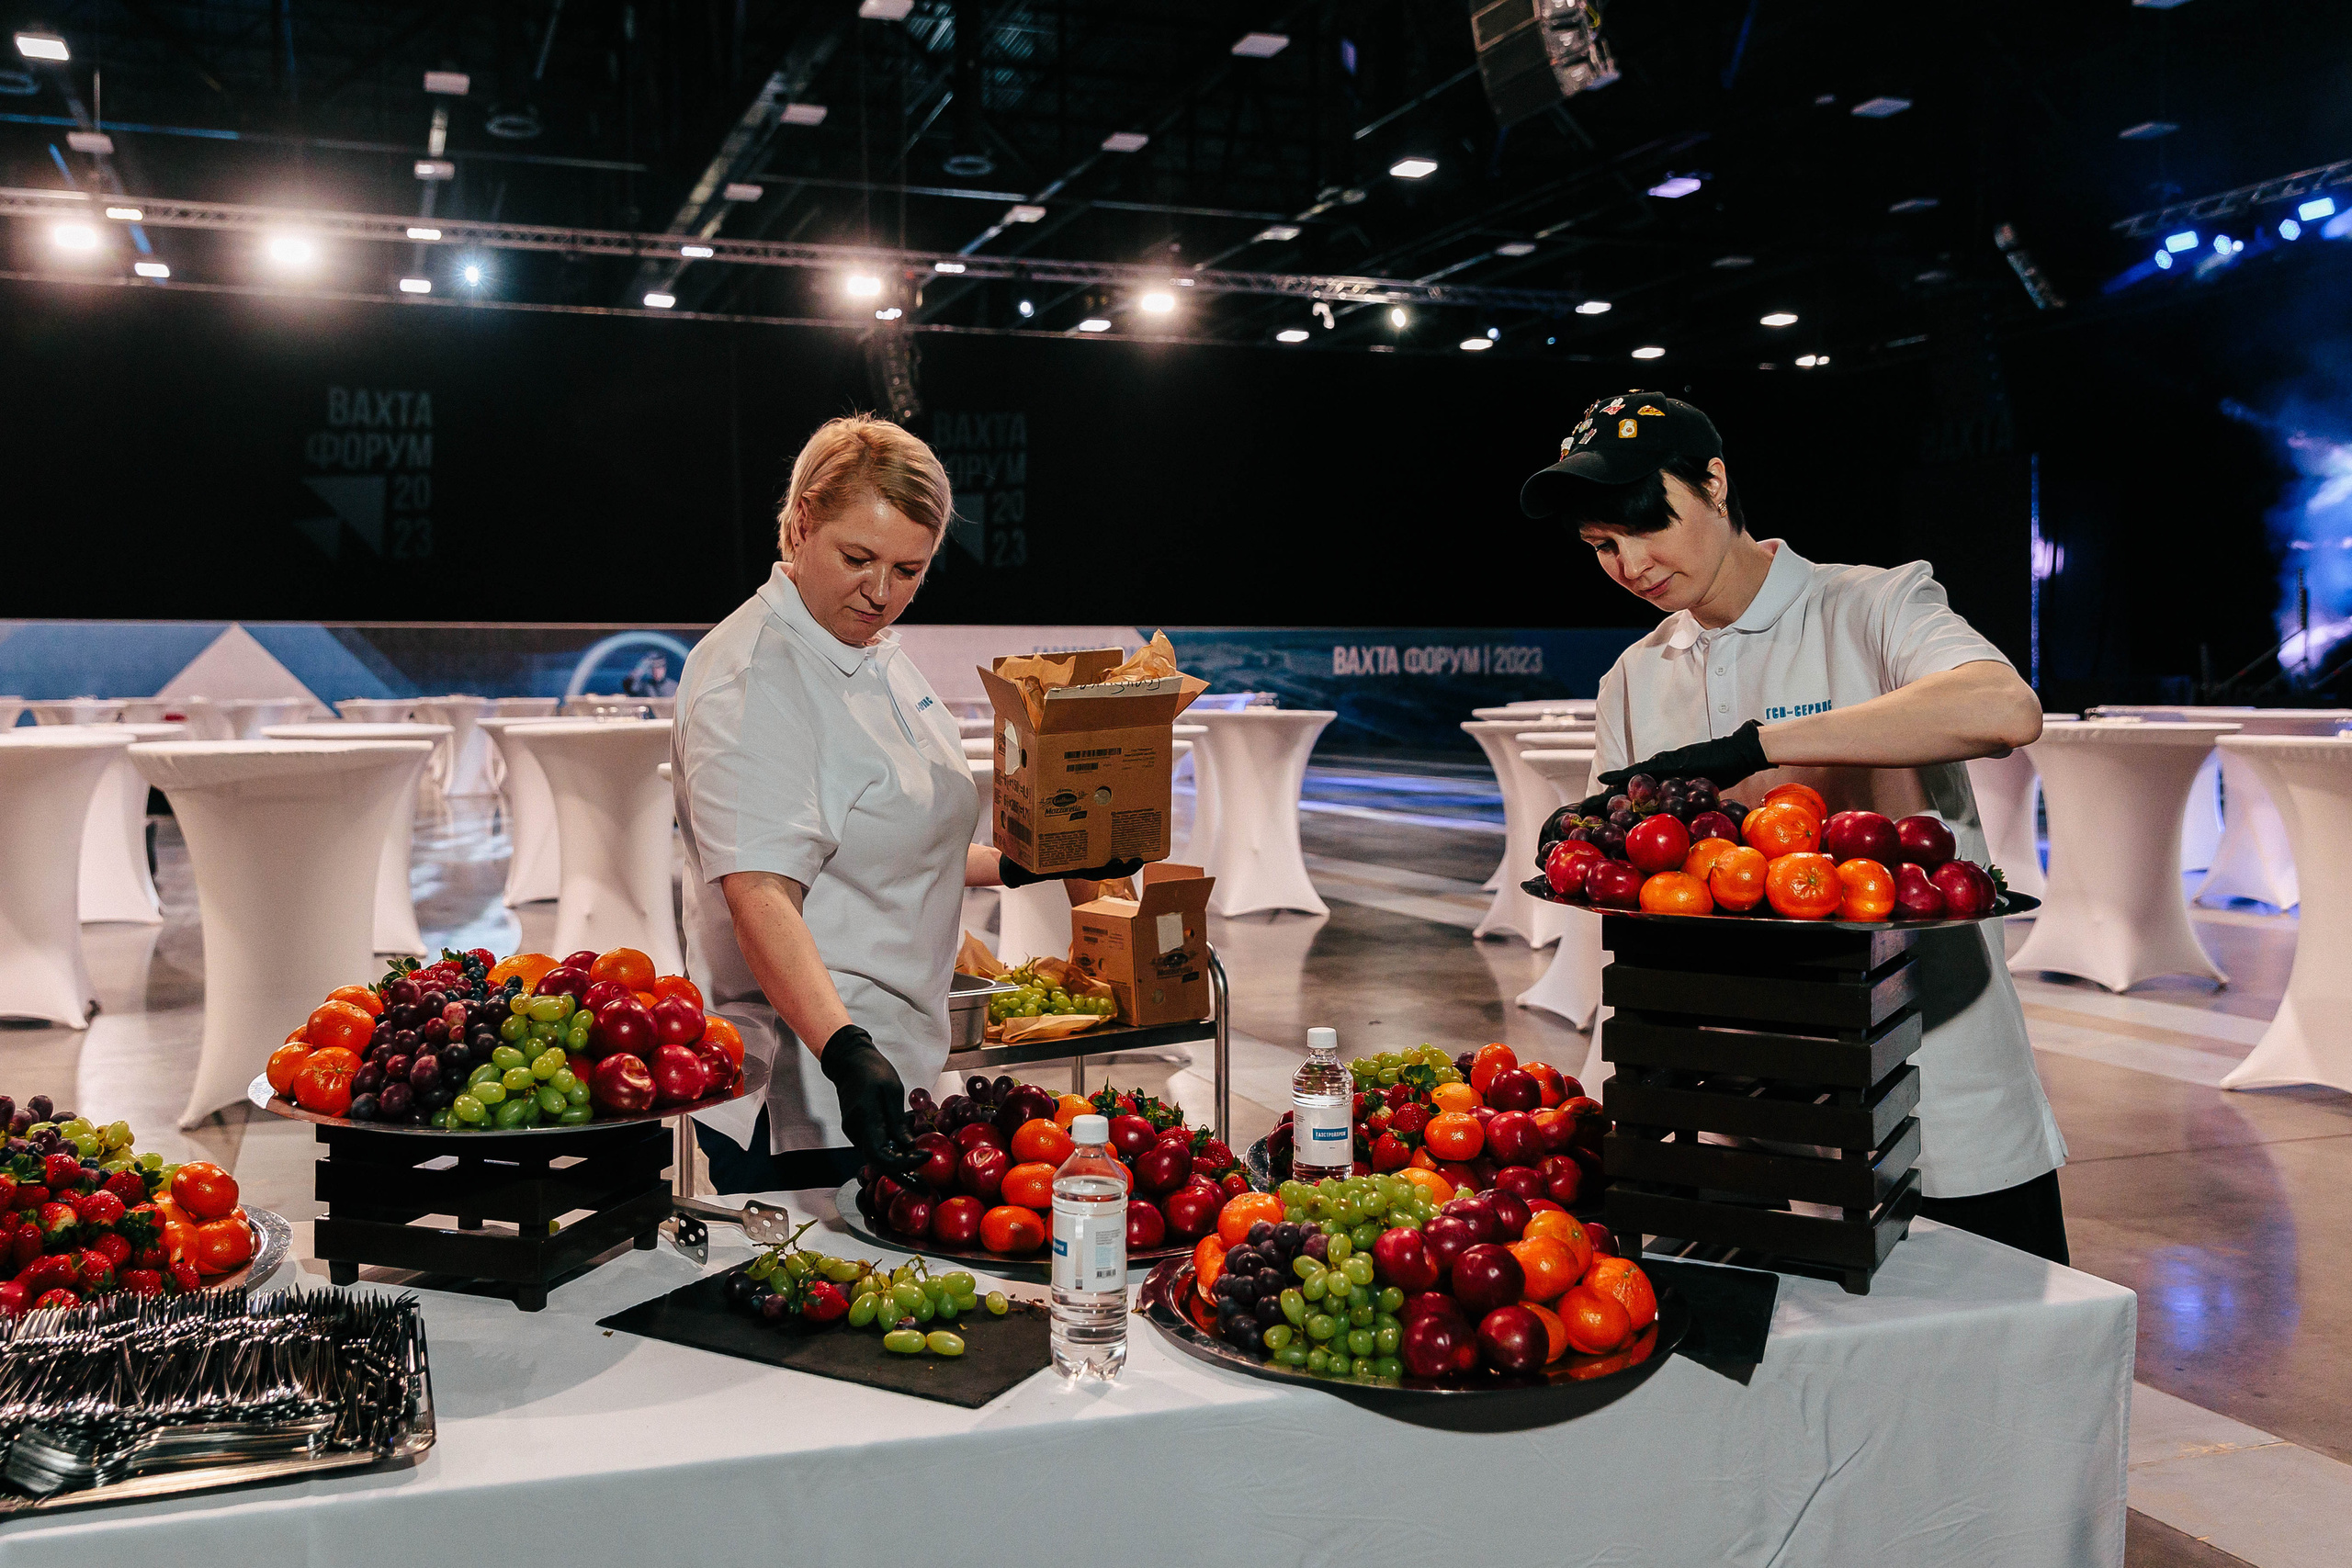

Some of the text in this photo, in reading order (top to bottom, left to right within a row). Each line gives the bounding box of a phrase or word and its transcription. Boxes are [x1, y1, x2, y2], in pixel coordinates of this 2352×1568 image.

[327, 386, 434, 427] ВАХТА
[932, 410, 1028, 447] ВАХТА
[304, 431, 434, 469] ФОРУМ
[944, 451, 1027, 488] ОРУМ
[391, 473, 433, 510] 20
[990, 489, 1025, 524] 20
[391, 516, 435, 558] 23
[990, 527, 1028, 568] 23
[1334, 646, 1543, 675] ВАХТА ФОРУМ 2023
